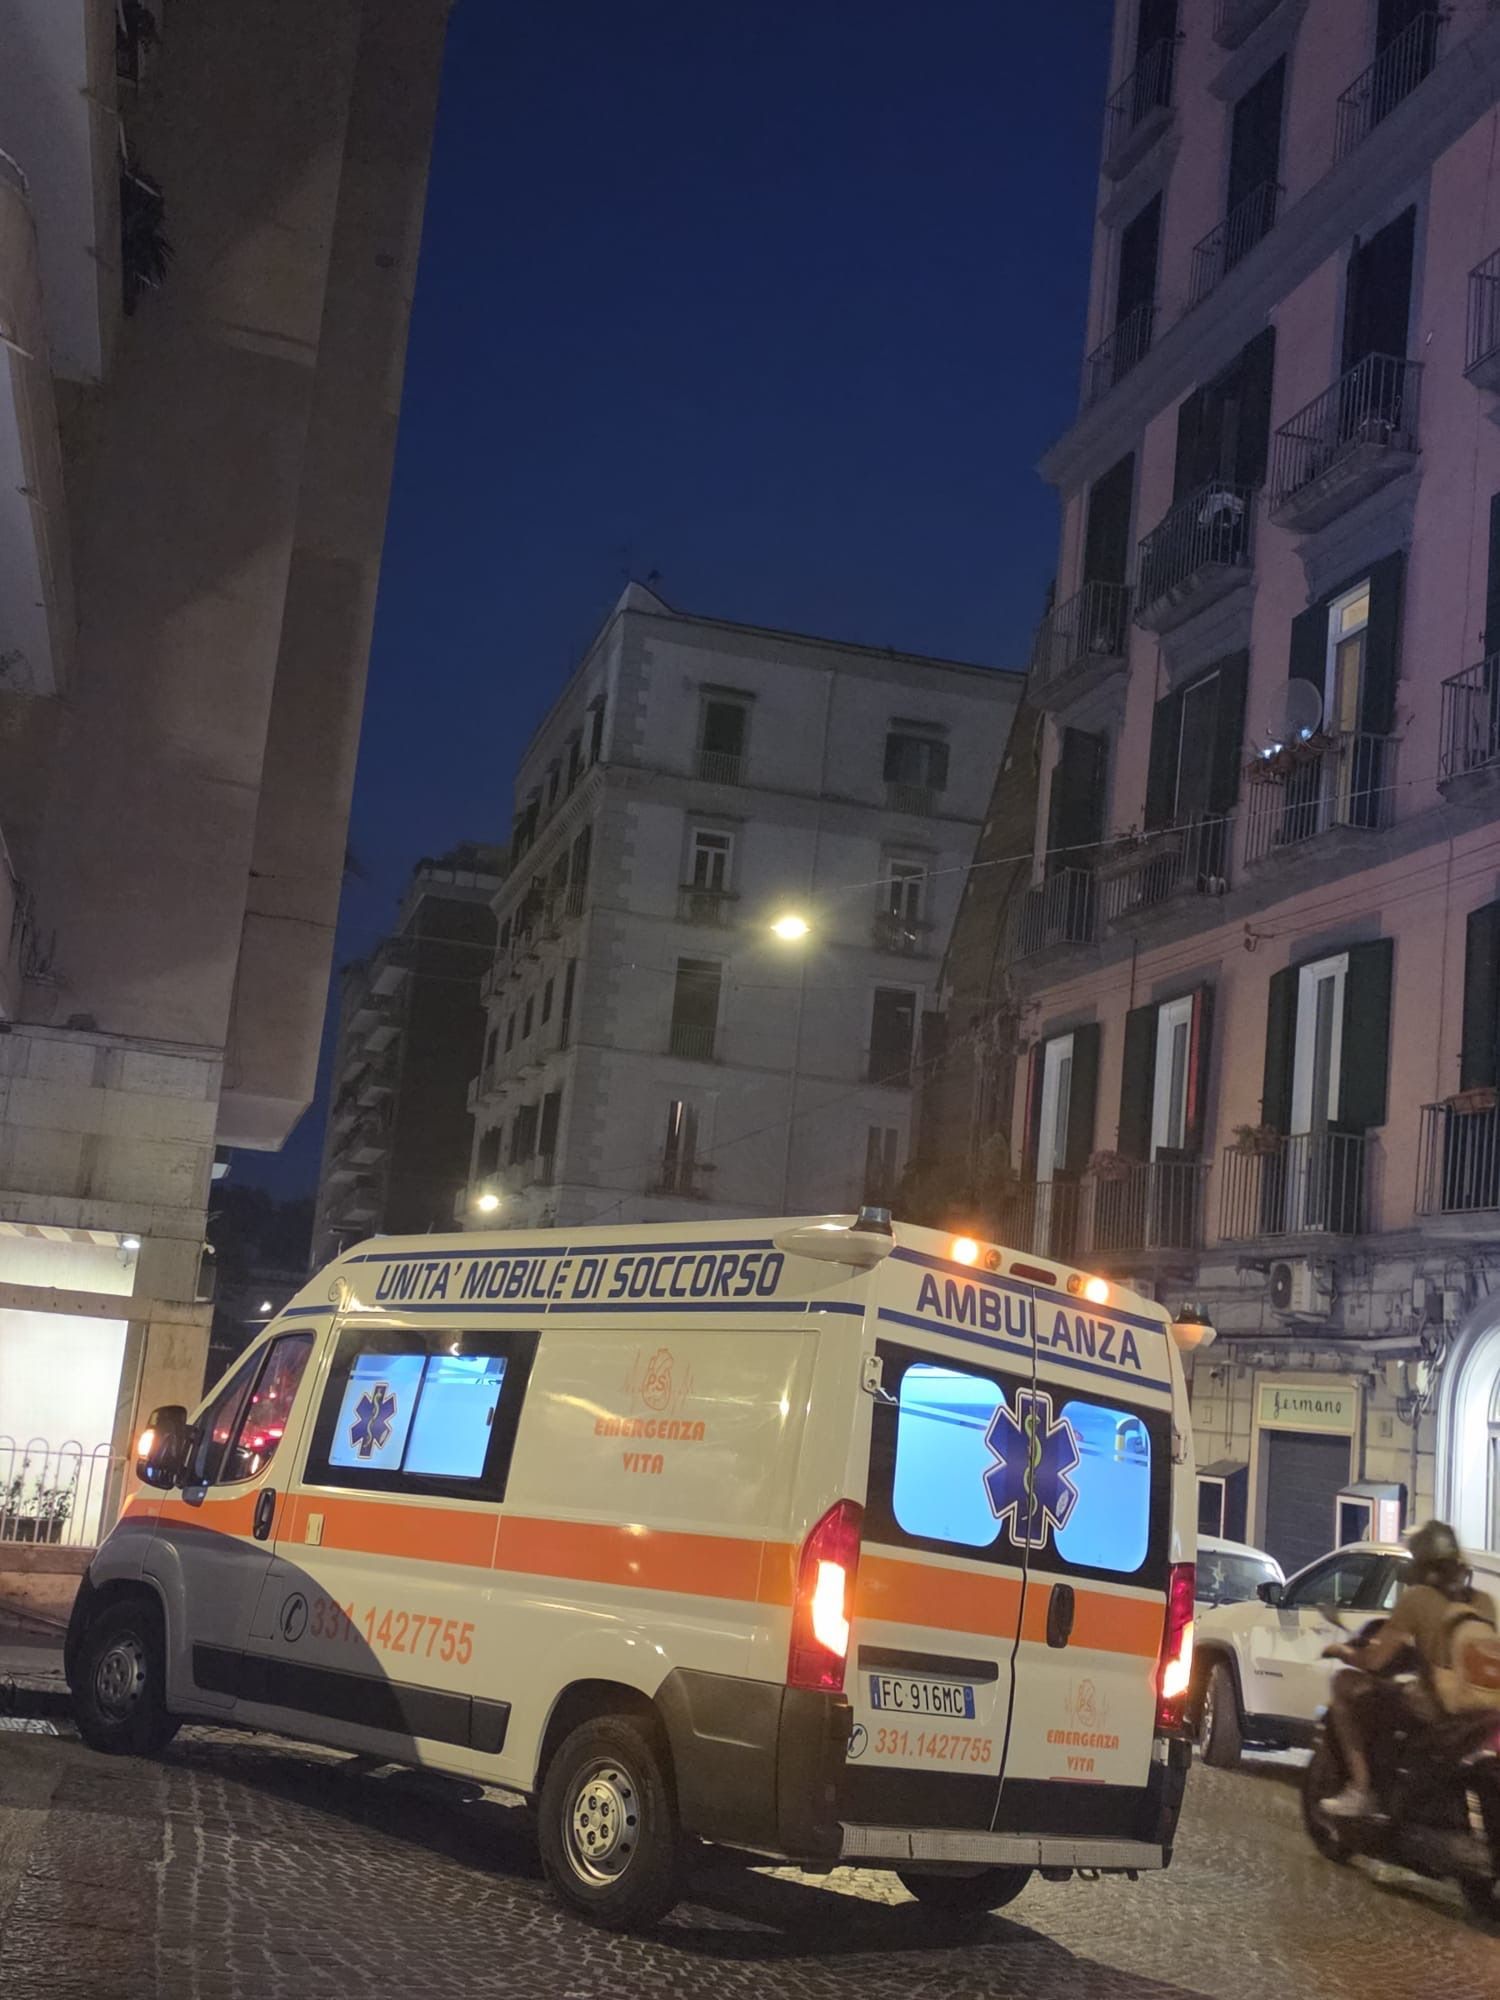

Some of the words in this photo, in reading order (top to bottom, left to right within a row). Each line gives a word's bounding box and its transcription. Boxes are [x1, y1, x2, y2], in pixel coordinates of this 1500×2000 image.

[375, 1262, 463, 1300] UNITA'
[460, 1259, 573, 1299] MOBILE
[571, 1258, 608, 1299] DI
[607, 1252, 785, 1298] SOCCORSO
[916, 1272, 1142, 1370] AMBULANZA
[594, 1418, 705, 1441] EMERGENZA
[623, 1452, 664, 1474] VITA
[311, 1598, 475, 1665] 331.1427755
[882, 1680, 903, 1708] FC
[911, 1683, 963, 1714] 916MC
[875, 1727, 993, 1763] 331.1427755
[1046, 1729, 1120, 1750] EMERGENZA
[1067, 1756, 1094, 1772] VITA
